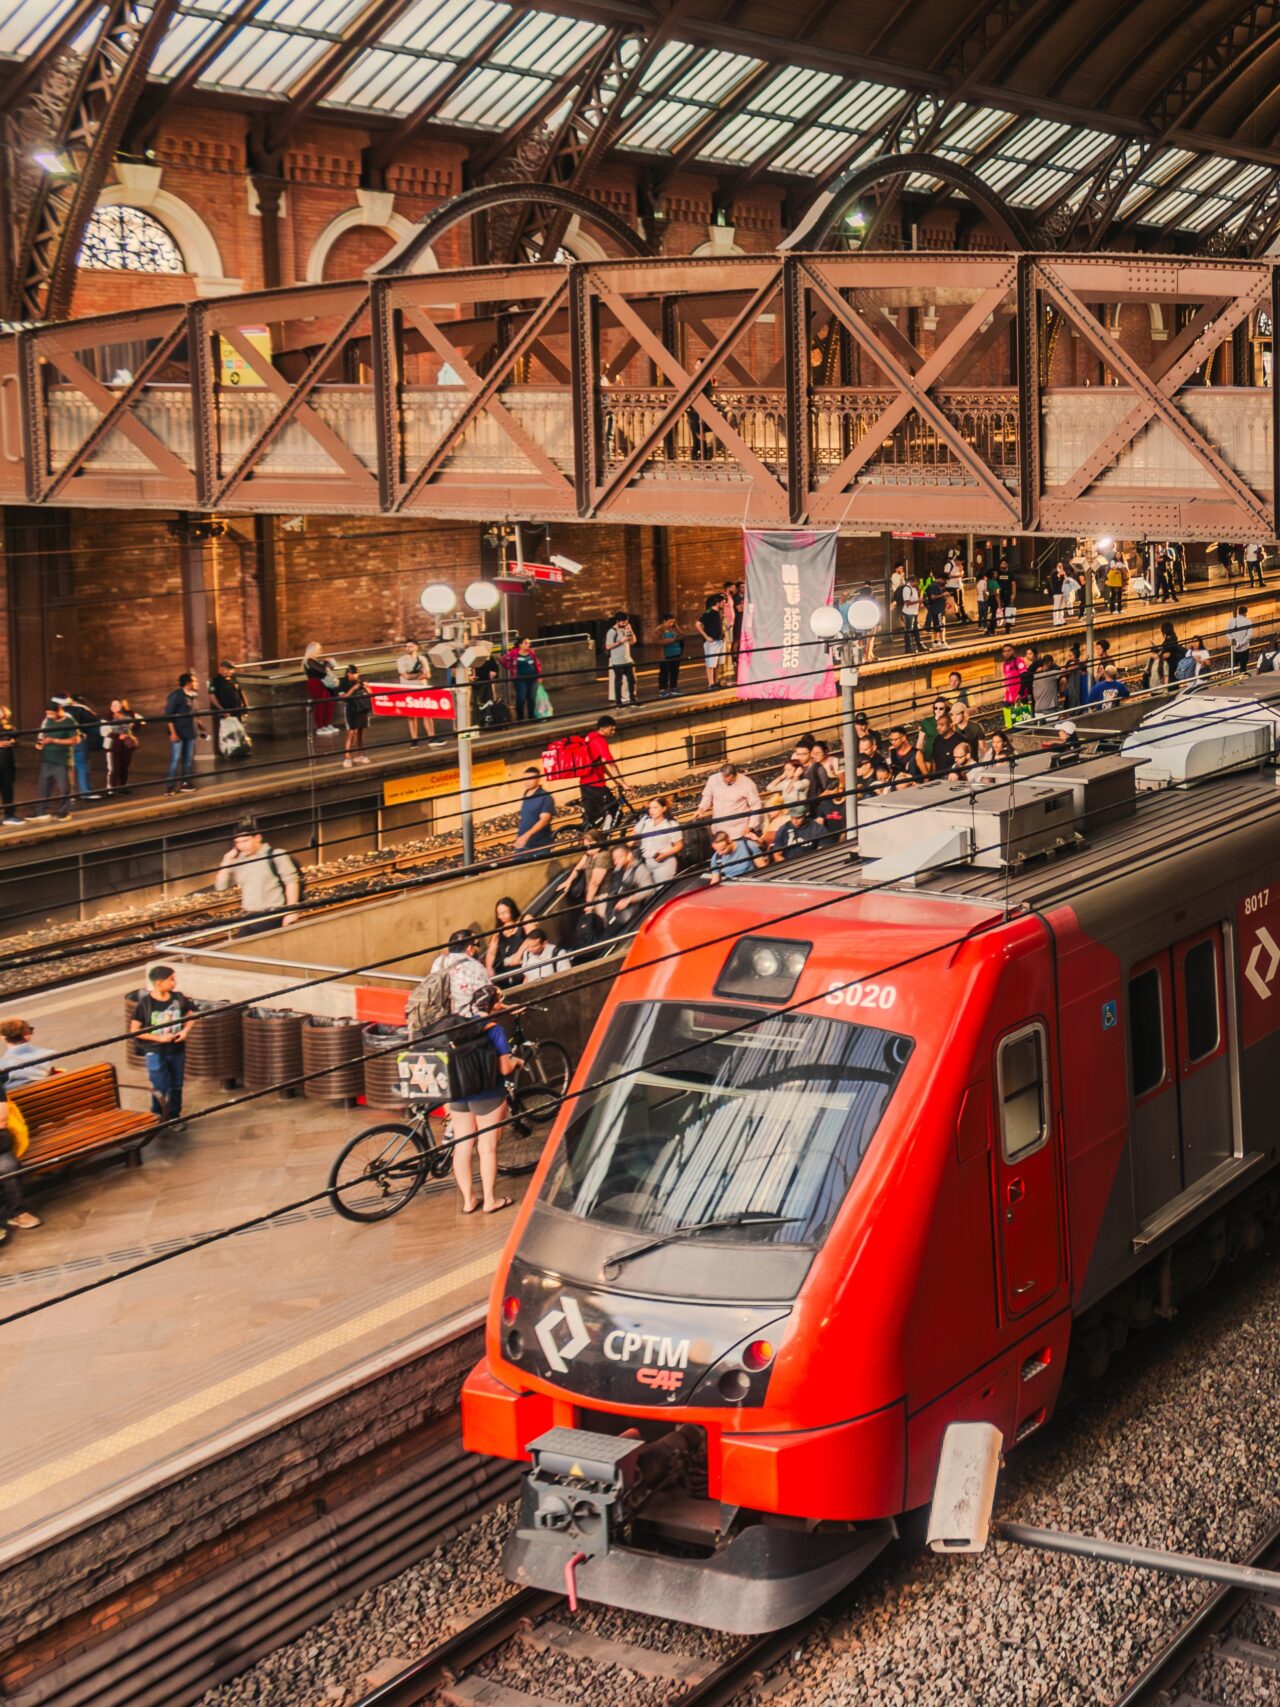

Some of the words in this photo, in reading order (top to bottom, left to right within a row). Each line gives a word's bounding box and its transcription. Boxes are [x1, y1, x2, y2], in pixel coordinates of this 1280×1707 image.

[783, 631, 791, 668] TODAS
[790, 633, 799, 668] PAULO
[1245, 888, 1269, 915] 8017
[603, 1330, 690, 1369] CPTM
[636, 1367, 684, 1391] CAF
